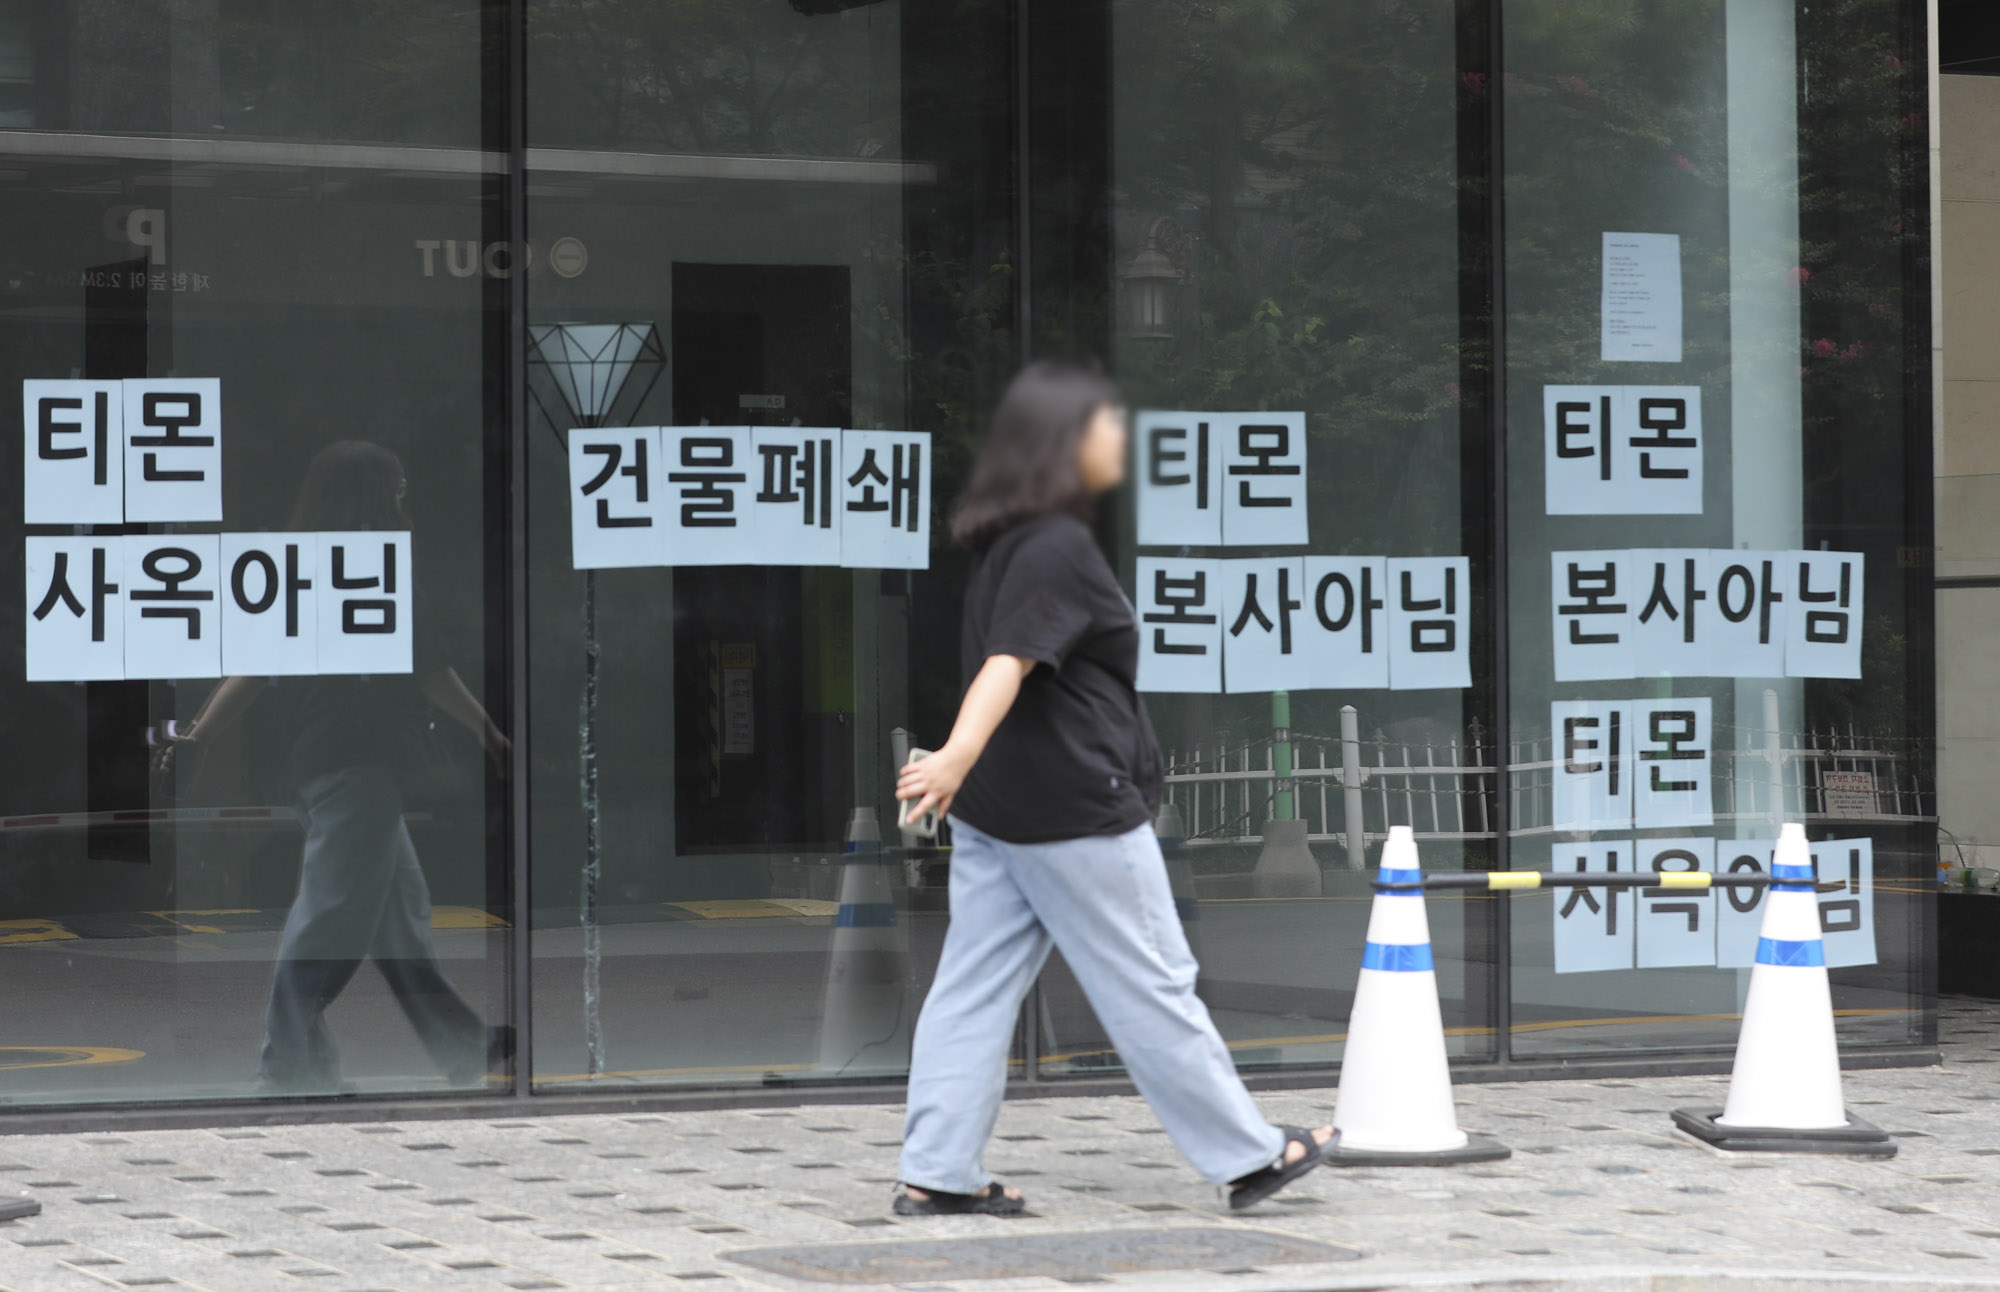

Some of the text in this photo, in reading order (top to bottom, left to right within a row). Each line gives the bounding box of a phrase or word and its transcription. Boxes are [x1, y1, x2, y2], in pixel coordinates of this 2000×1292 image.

[38, 391, 215, 485] 티몬
[1149, 422, 1301, 510] 티몬
[1556, 395, 1697, 481] 티몬
[581, 437, 921, 532] 건물폐쇄
[33, 543, 396, 642] 사옥아님
[1143, 567, 1456, 655] 본사아님
[1558, 558, 1851, 645] 본사아님
[1564, 710, 1705, 796] 티몬
